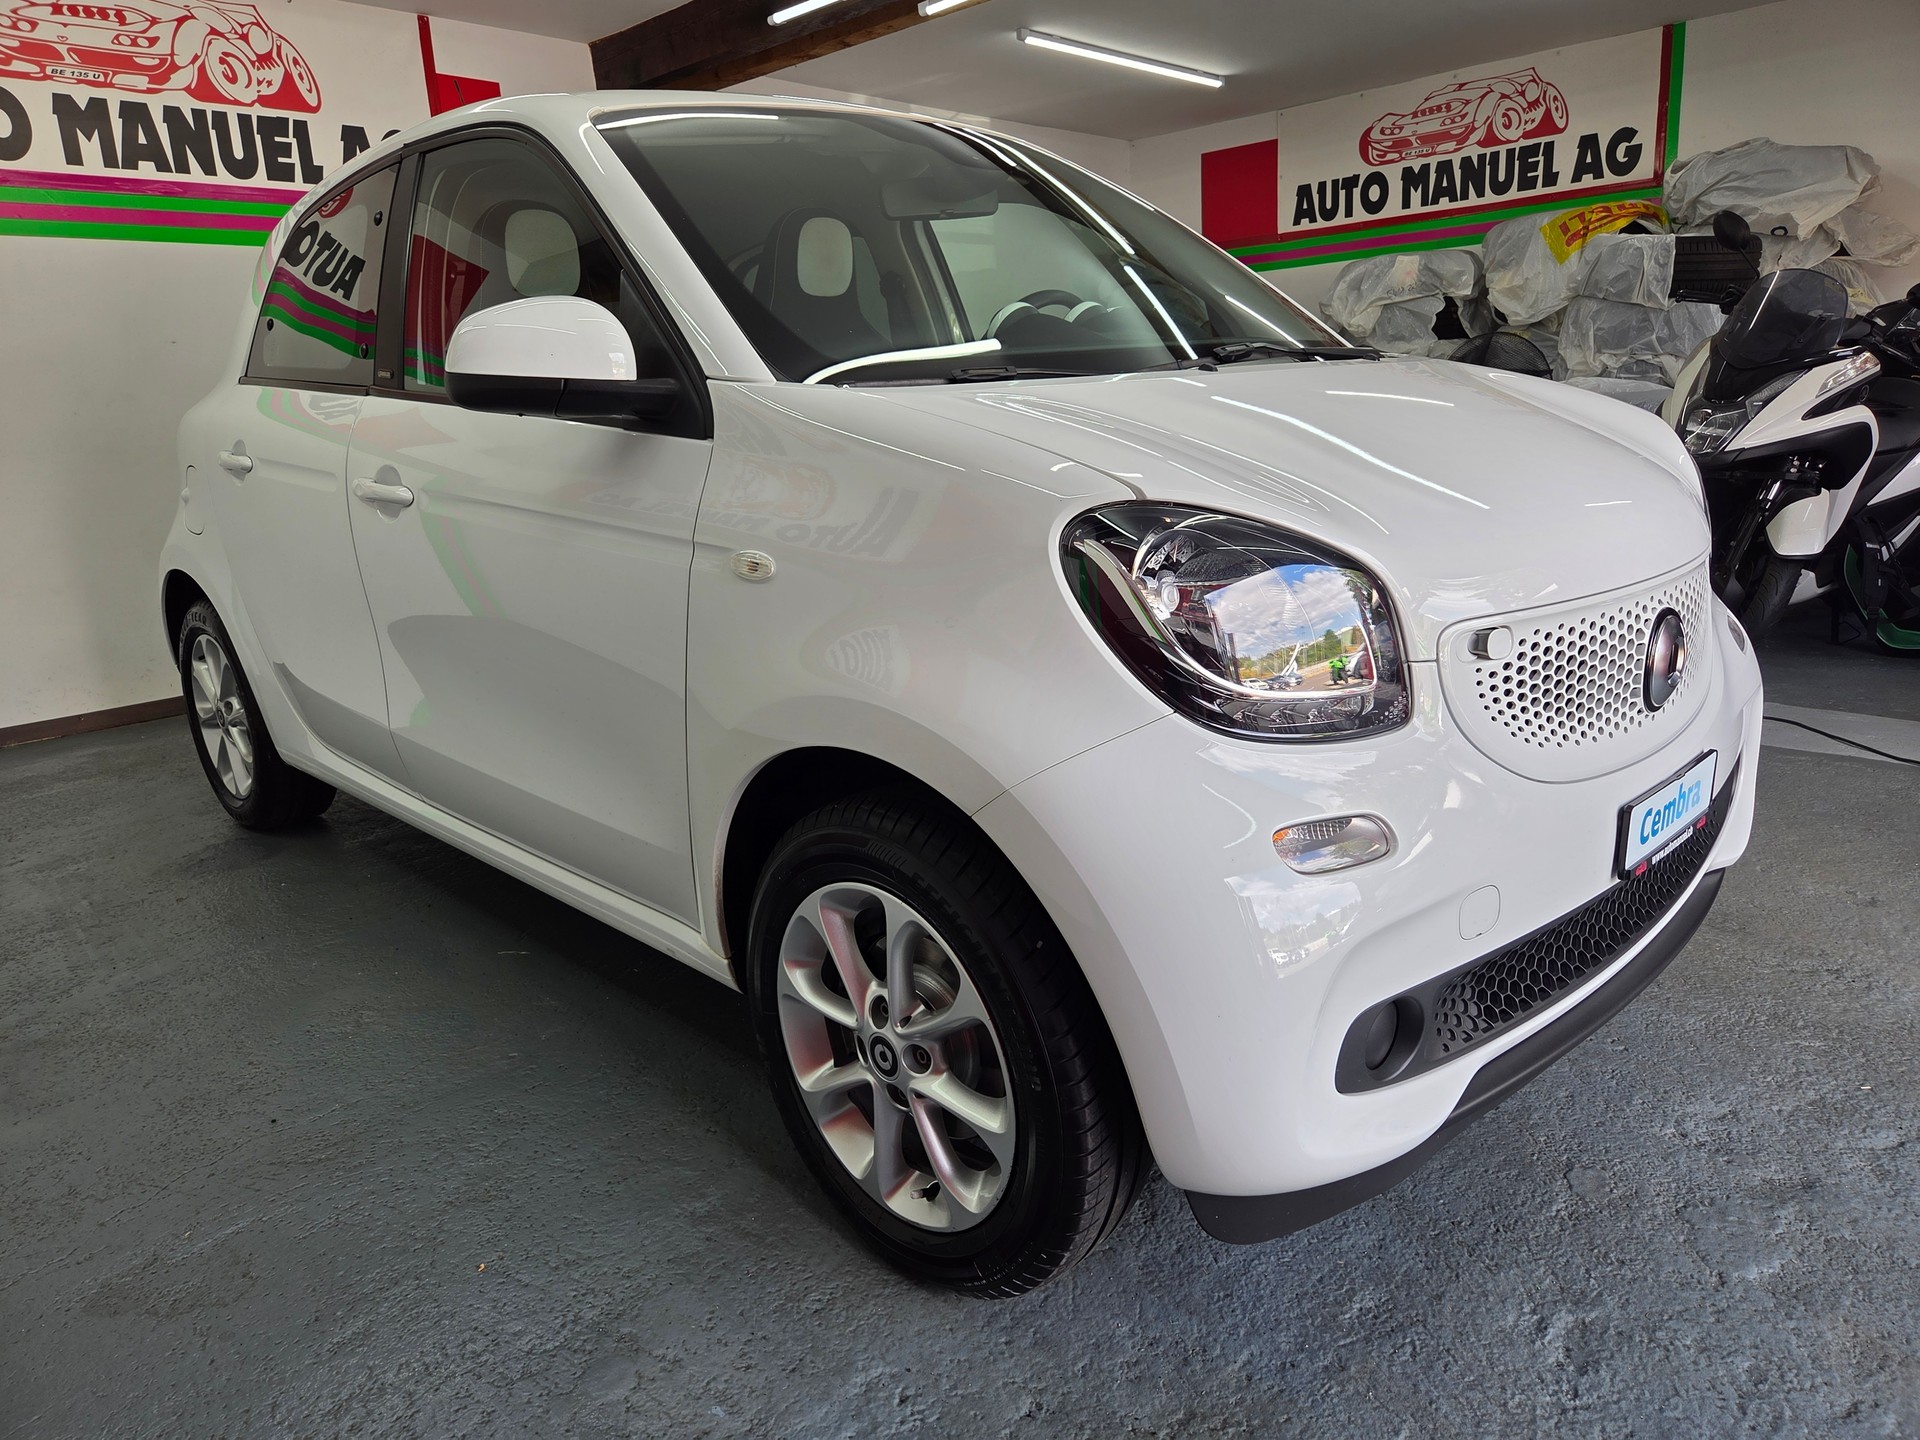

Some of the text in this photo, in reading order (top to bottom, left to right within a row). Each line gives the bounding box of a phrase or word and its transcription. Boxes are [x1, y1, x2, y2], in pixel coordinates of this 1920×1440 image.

[51, 68, 67, 76] BE
[70, 71, 90, 79] 135
[52, 92, 324, 185] MANUEL
[341, 124, 401, 165] A
[1292, 126, 1643, 226] AUTO MANUEL AG
[1639, 780, 1702, 846] Cembra
